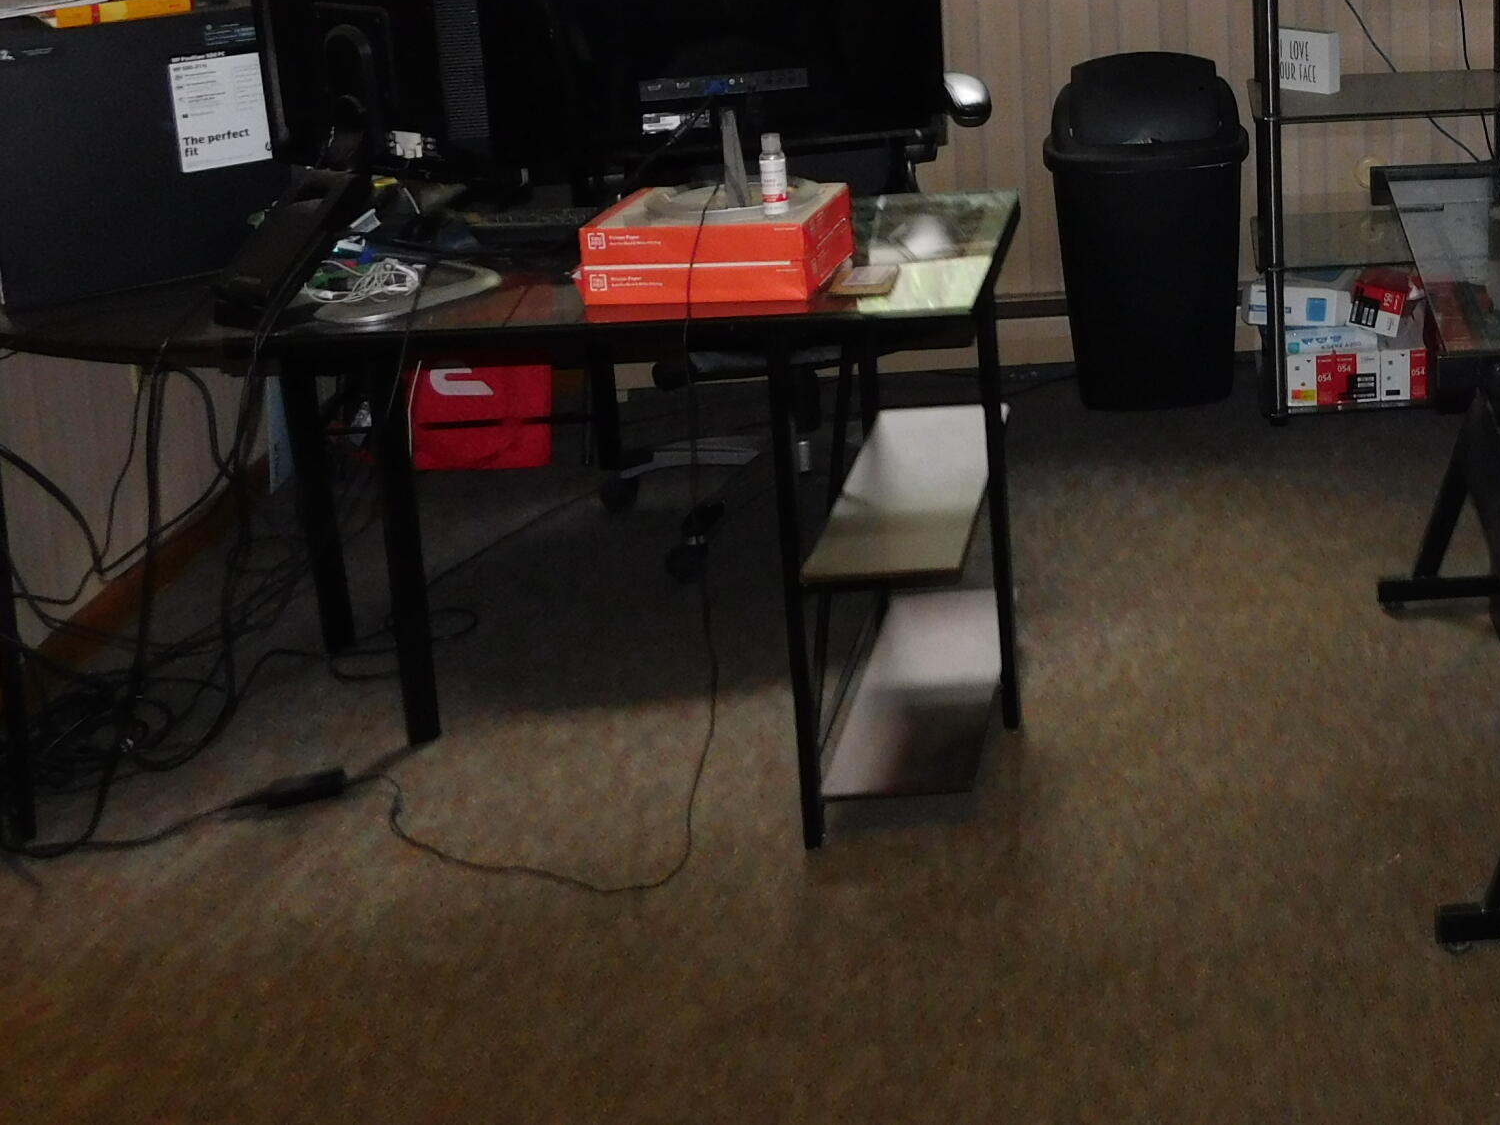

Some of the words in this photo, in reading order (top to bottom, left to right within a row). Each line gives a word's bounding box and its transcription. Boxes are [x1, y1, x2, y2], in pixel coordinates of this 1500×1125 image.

[1290, 40, 1309, 62] LOVE
[1279, 61, 1296, 81] OUR
[1299, 63, 1317, 84] FACE
[183, 134, 205, 147] The
[207, 128, 250, 145] perfect
[184, 146, 199, 157] fit
[1337, 363, 1352, 373] 054
[1411, 368, 1425, 377] 054
[1317, 373, 1332, 383] 054
